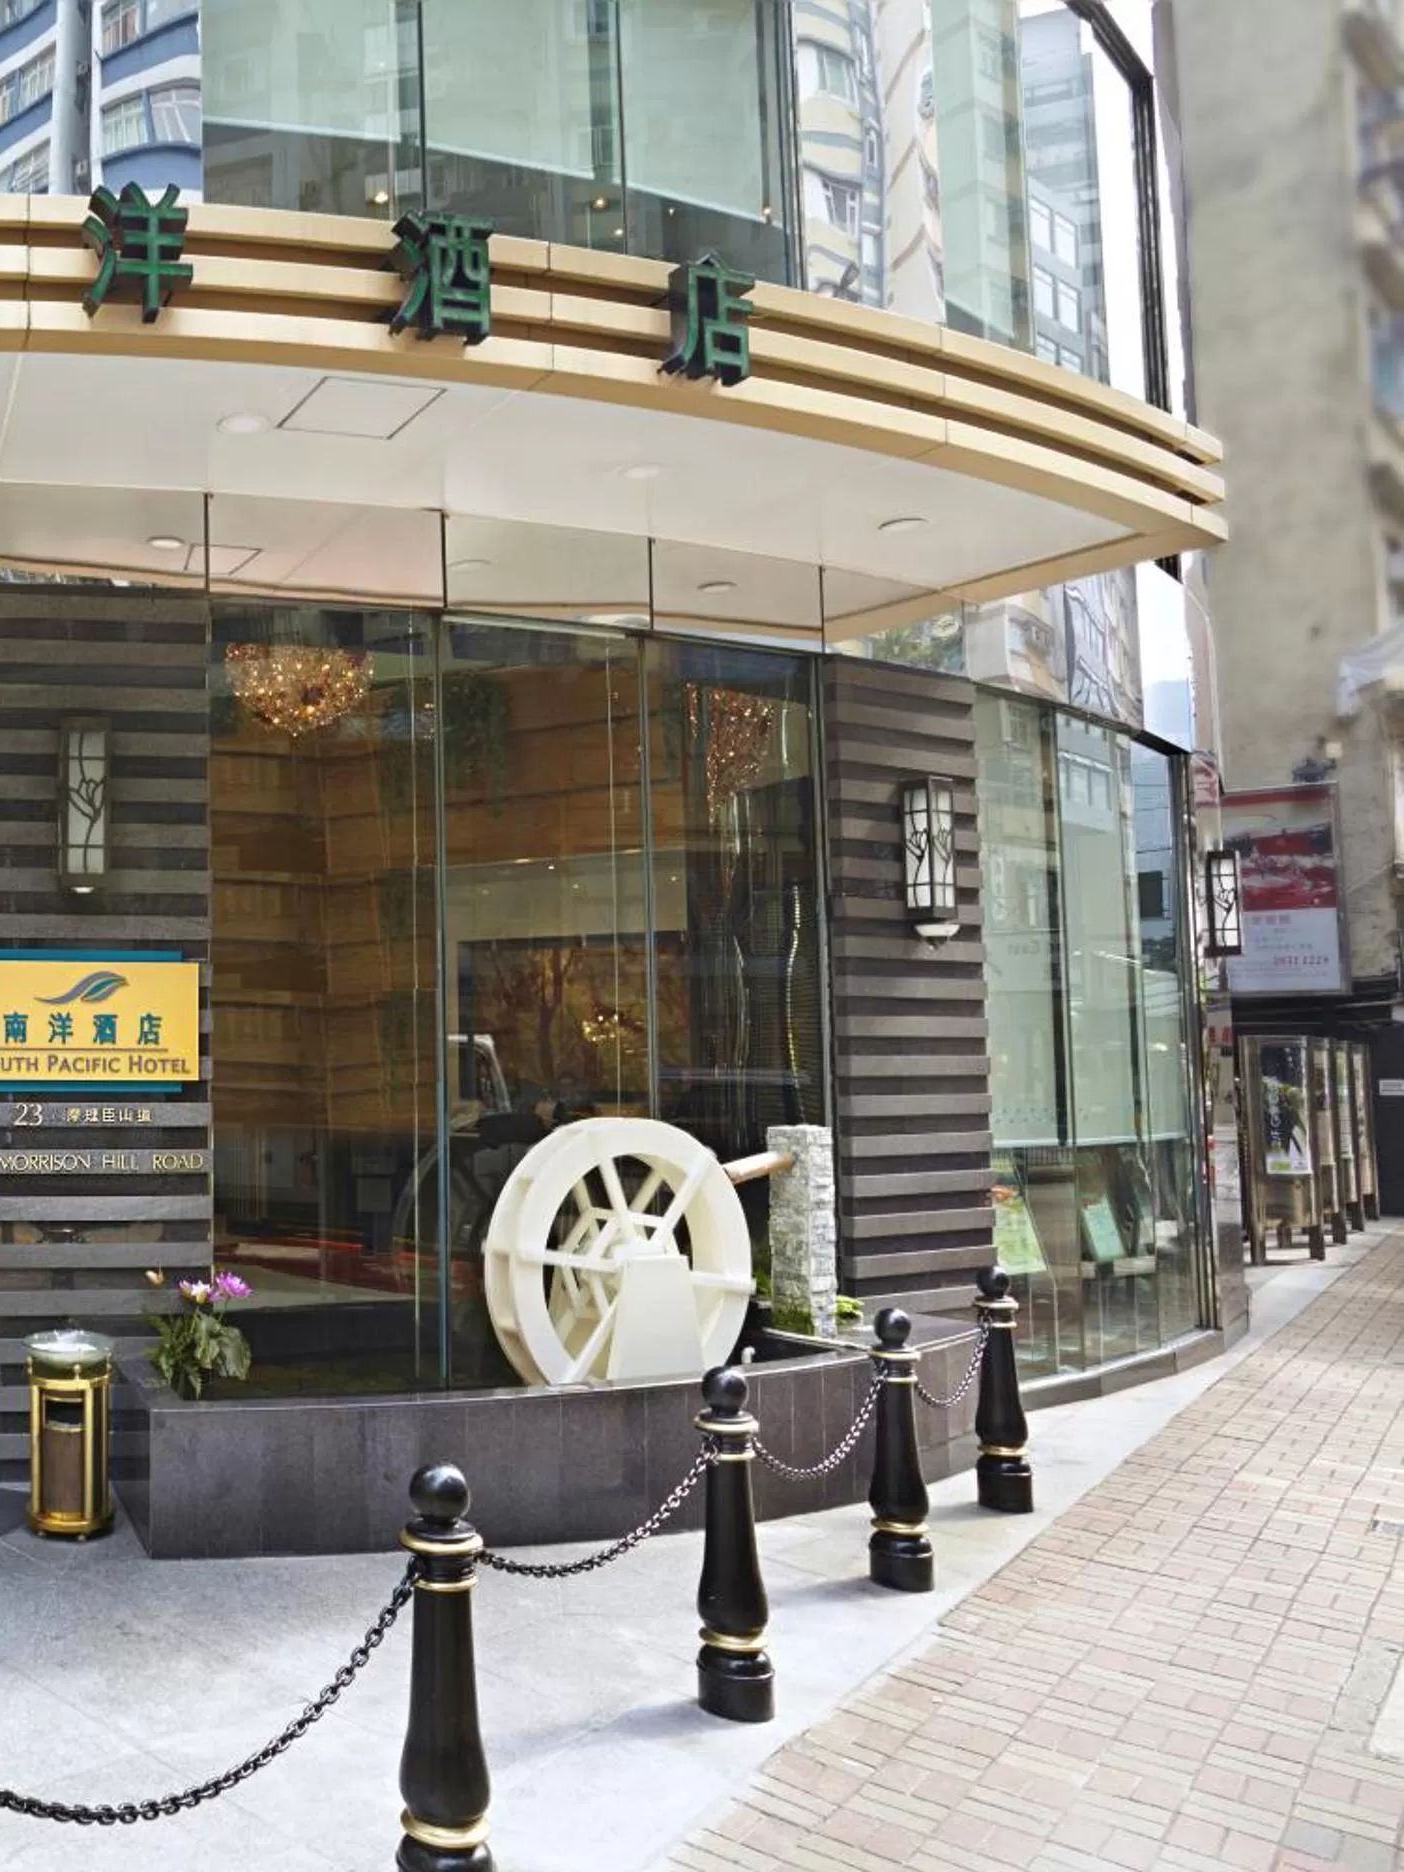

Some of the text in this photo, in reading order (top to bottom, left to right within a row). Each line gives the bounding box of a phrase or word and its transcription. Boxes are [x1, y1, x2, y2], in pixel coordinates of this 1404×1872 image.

[3, 1011, 163, 1046] 南洋酒店
[47, 1053, 121, 1074] PACIFIC
[128, 1054, 191, 1075] HOTEL
[13, 1102, 43, 1126] 23
[102, 1152, 140, 1171] HILL
[152, 1152, 204, 1171] ROAD
